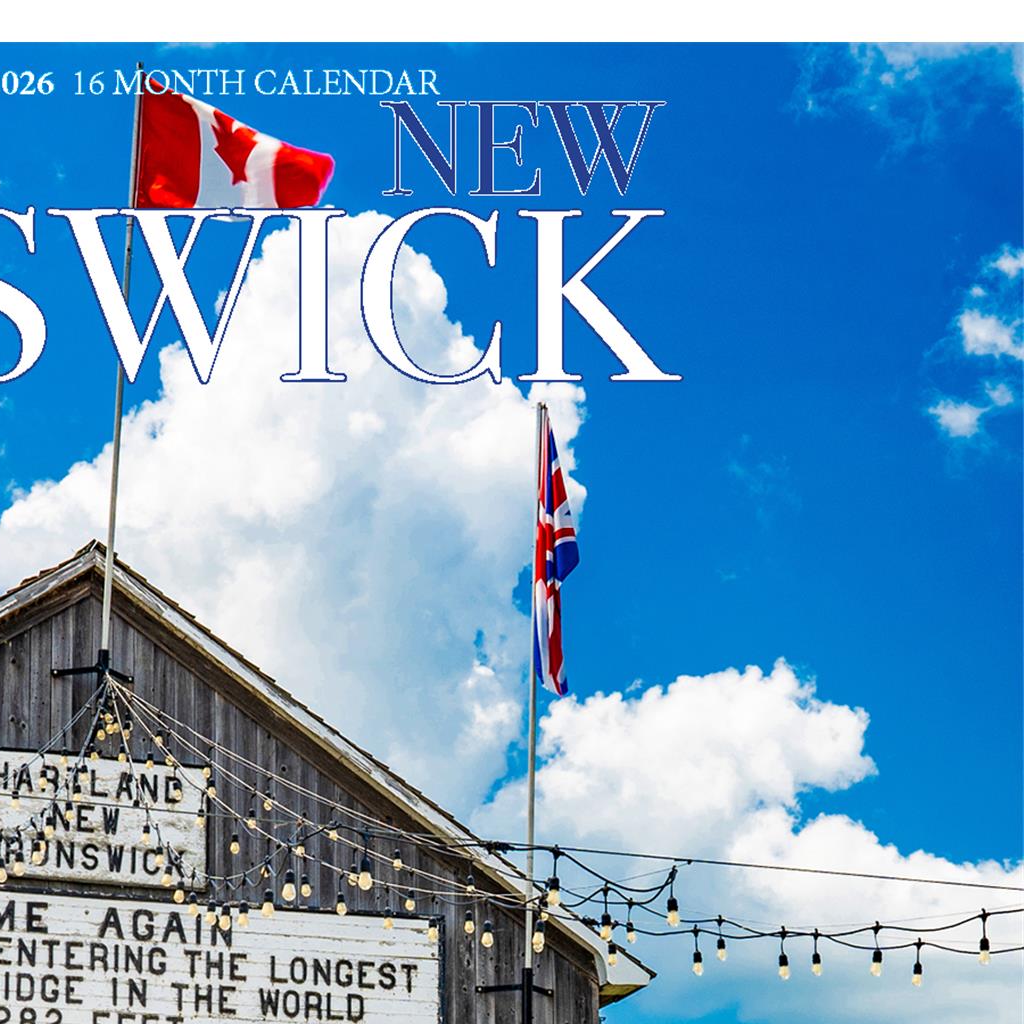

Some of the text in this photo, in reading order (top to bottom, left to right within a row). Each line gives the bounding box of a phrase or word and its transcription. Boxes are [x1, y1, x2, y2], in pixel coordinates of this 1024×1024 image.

[51, 802, 120, 835] NEW
[98, 907, 233, 947] AGAIN
[184, 950, 247, 981] THE
[270, 955, 418, 993] LONGEST
[112, 978, 147, 1008] IN
[171, 983, 237, 1014] THE
[260, 988, 365, 1023] WORLD
